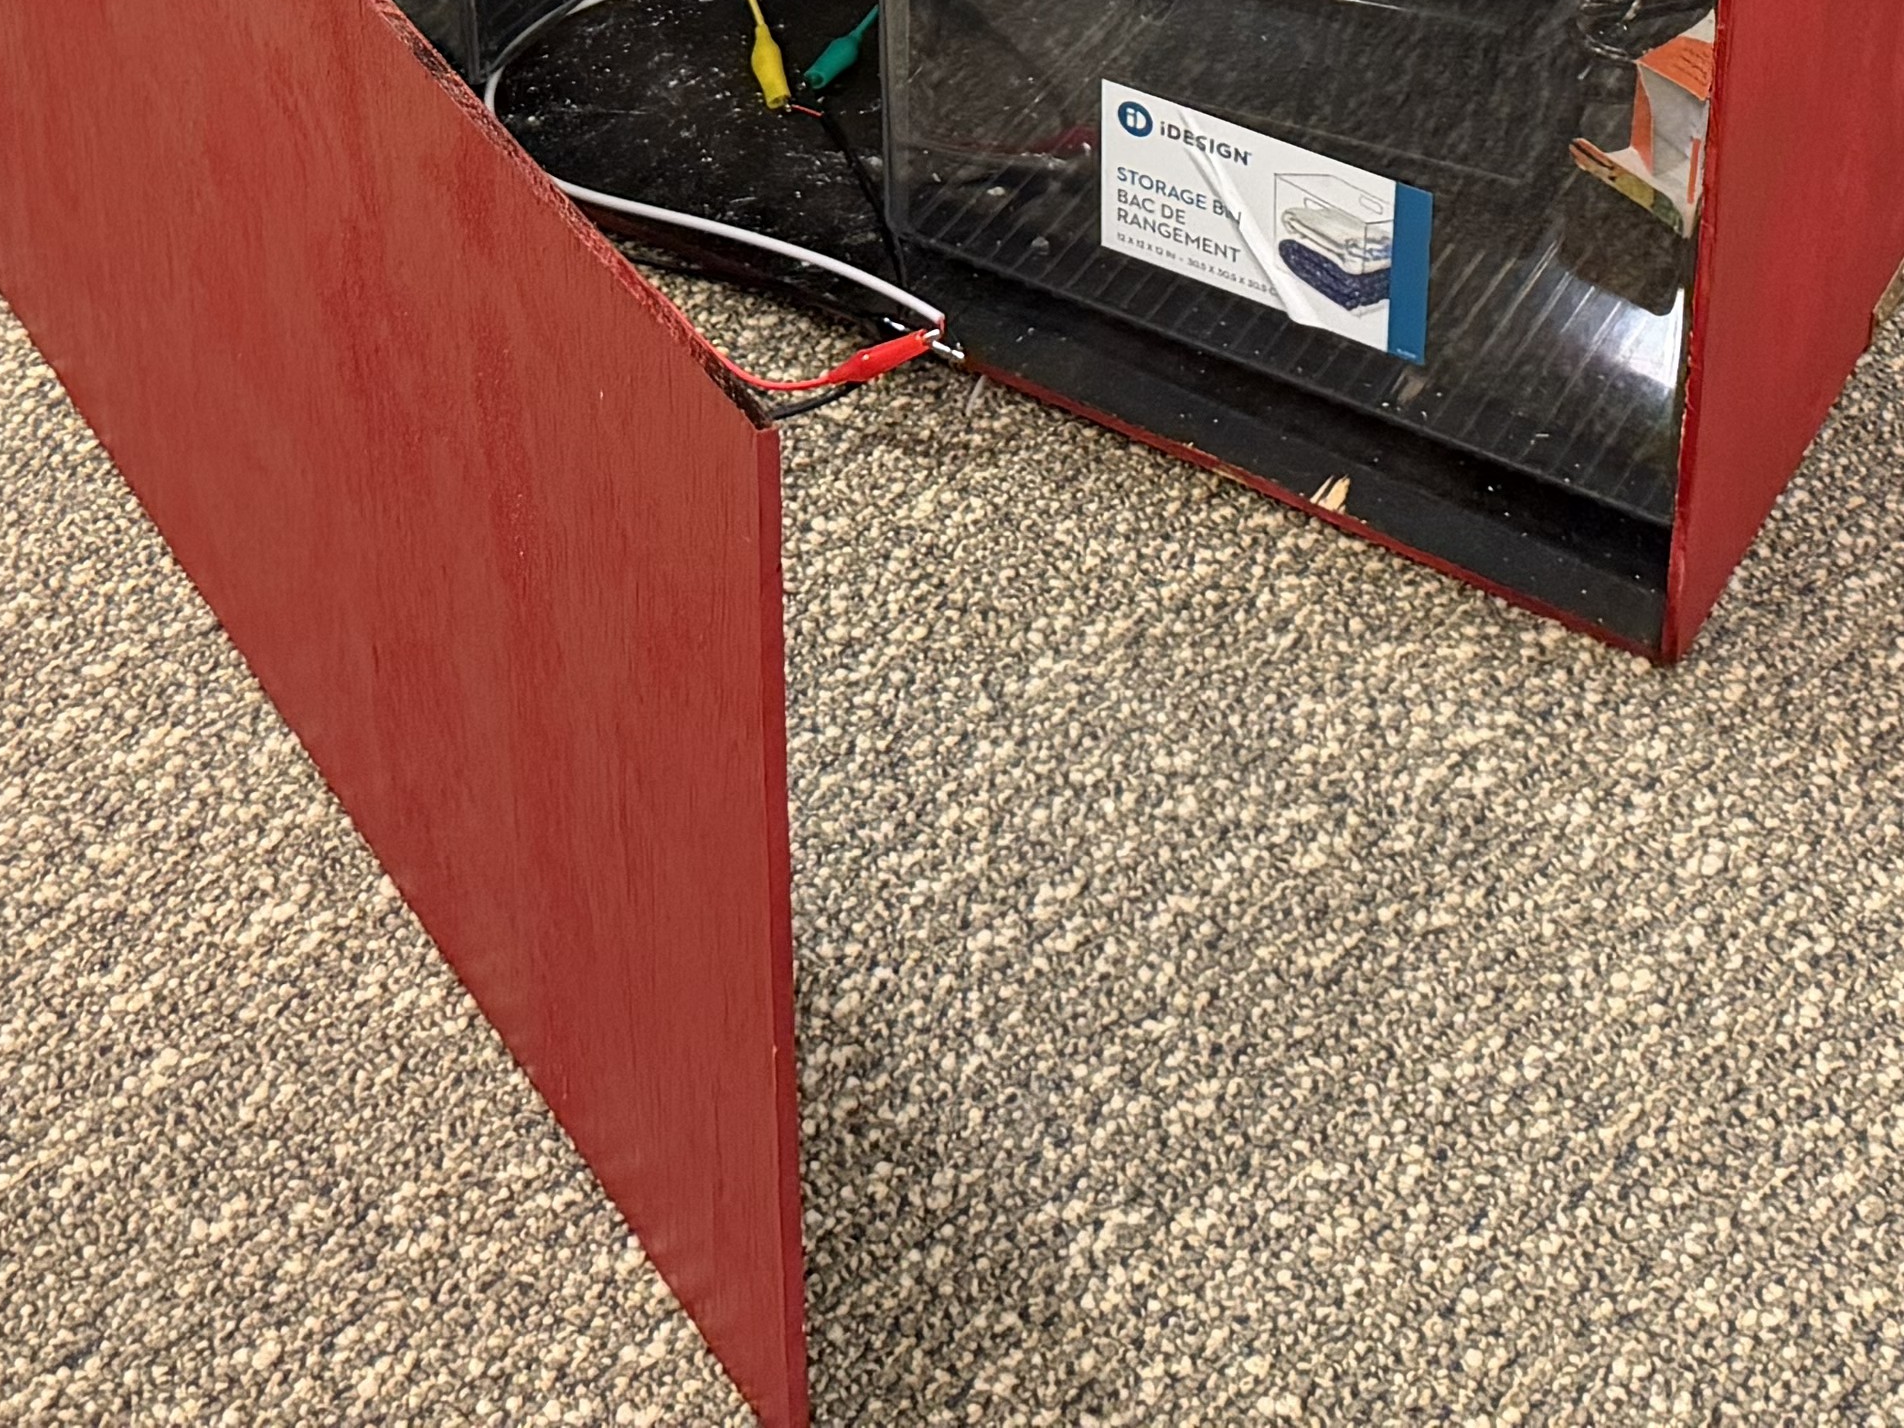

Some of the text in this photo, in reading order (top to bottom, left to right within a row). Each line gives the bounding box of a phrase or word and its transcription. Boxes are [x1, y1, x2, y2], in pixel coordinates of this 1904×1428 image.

[1117, 166, 1207, 210] STORAGE
[1117, 188, 1187, 225] BAC DE
[1117, 207, 1241, 263] RANGEMENT
